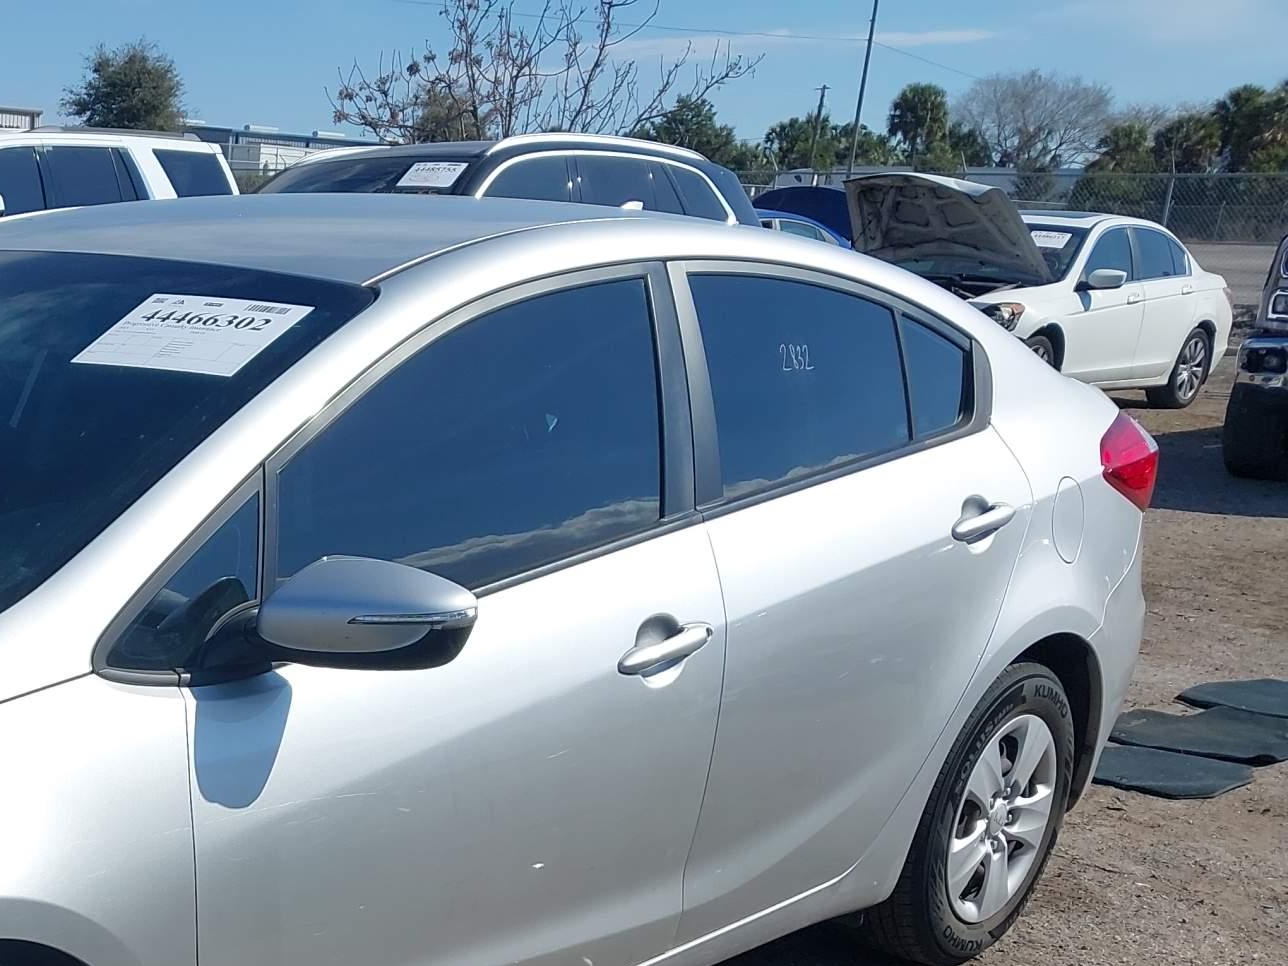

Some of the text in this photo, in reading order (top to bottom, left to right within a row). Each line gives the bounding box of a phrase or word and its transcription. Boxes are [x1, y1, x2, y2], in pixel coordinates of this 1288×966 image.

[141, 309, 272, 331] 44466302
[779, 343, 815, 371] 2832
[1033, 684, 1068, 718] KUMHO
[943, 924, 982, 951] KUMHO
